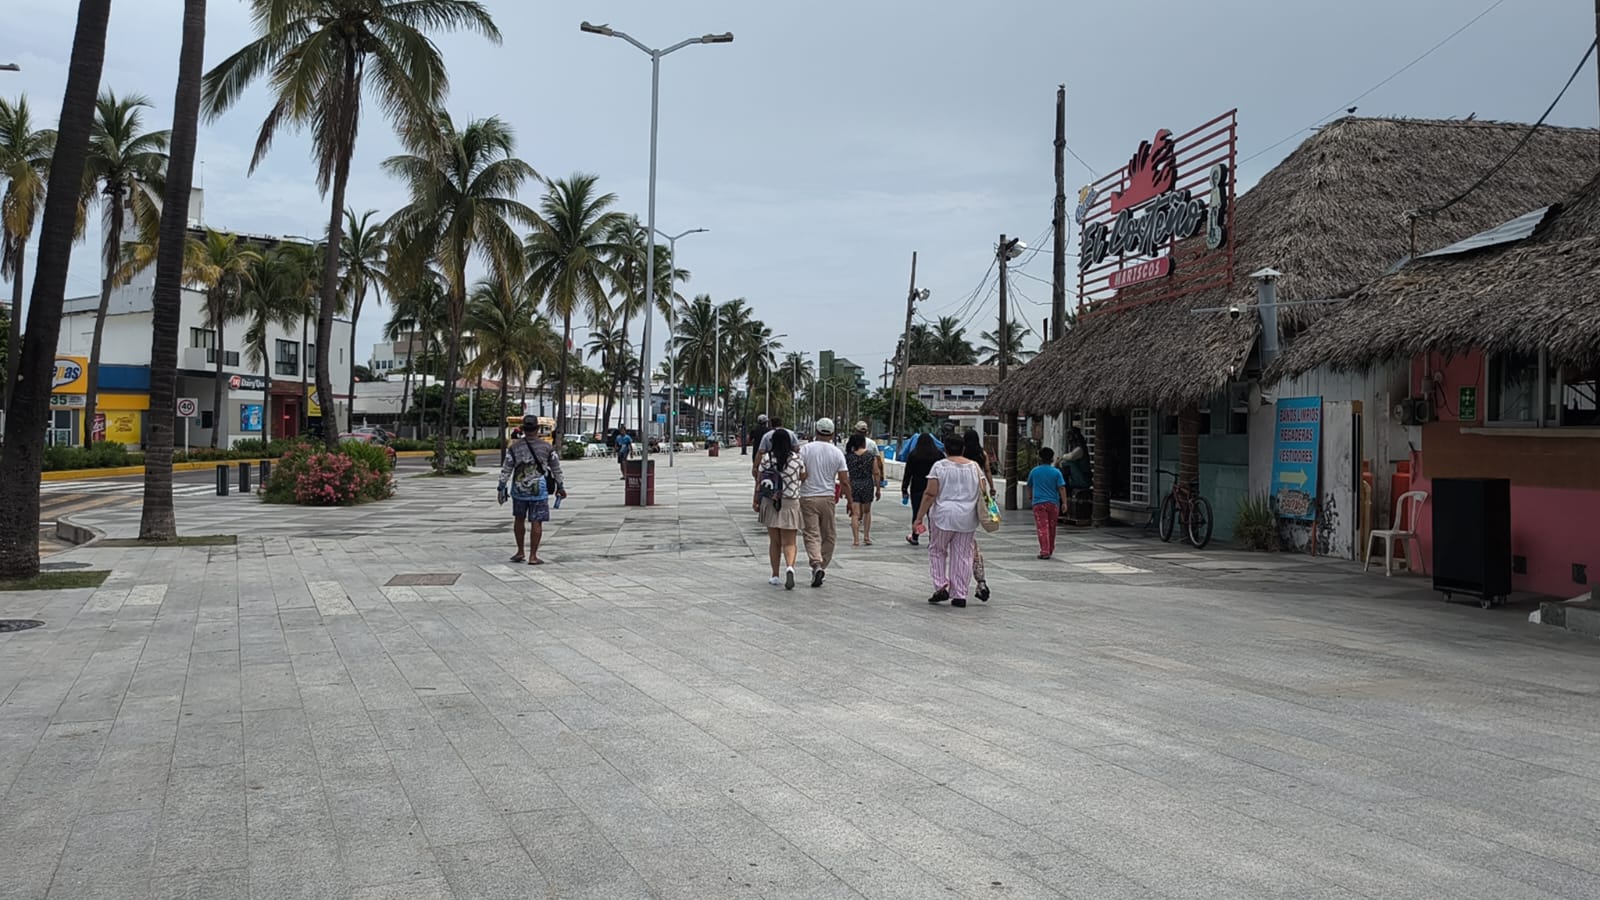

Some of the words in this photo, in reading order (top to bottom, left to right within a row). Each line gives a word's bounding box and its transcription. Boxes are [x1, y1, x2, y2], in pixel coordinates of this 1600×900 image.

[1080, 221, 1106, 270] El
[1109, 192, 1203, 257] Costeño
[1114, 261, 1161, 285] MARISCOS
[51, 365, 79, 381] epas
[181, 402, 192, 411] 40
[1297, 407, 1319, 422] LIMPIOS
[1280, 428, 1313, 442] REGADERAS
[1279, 450, 1313, 463] VESTIDORES
